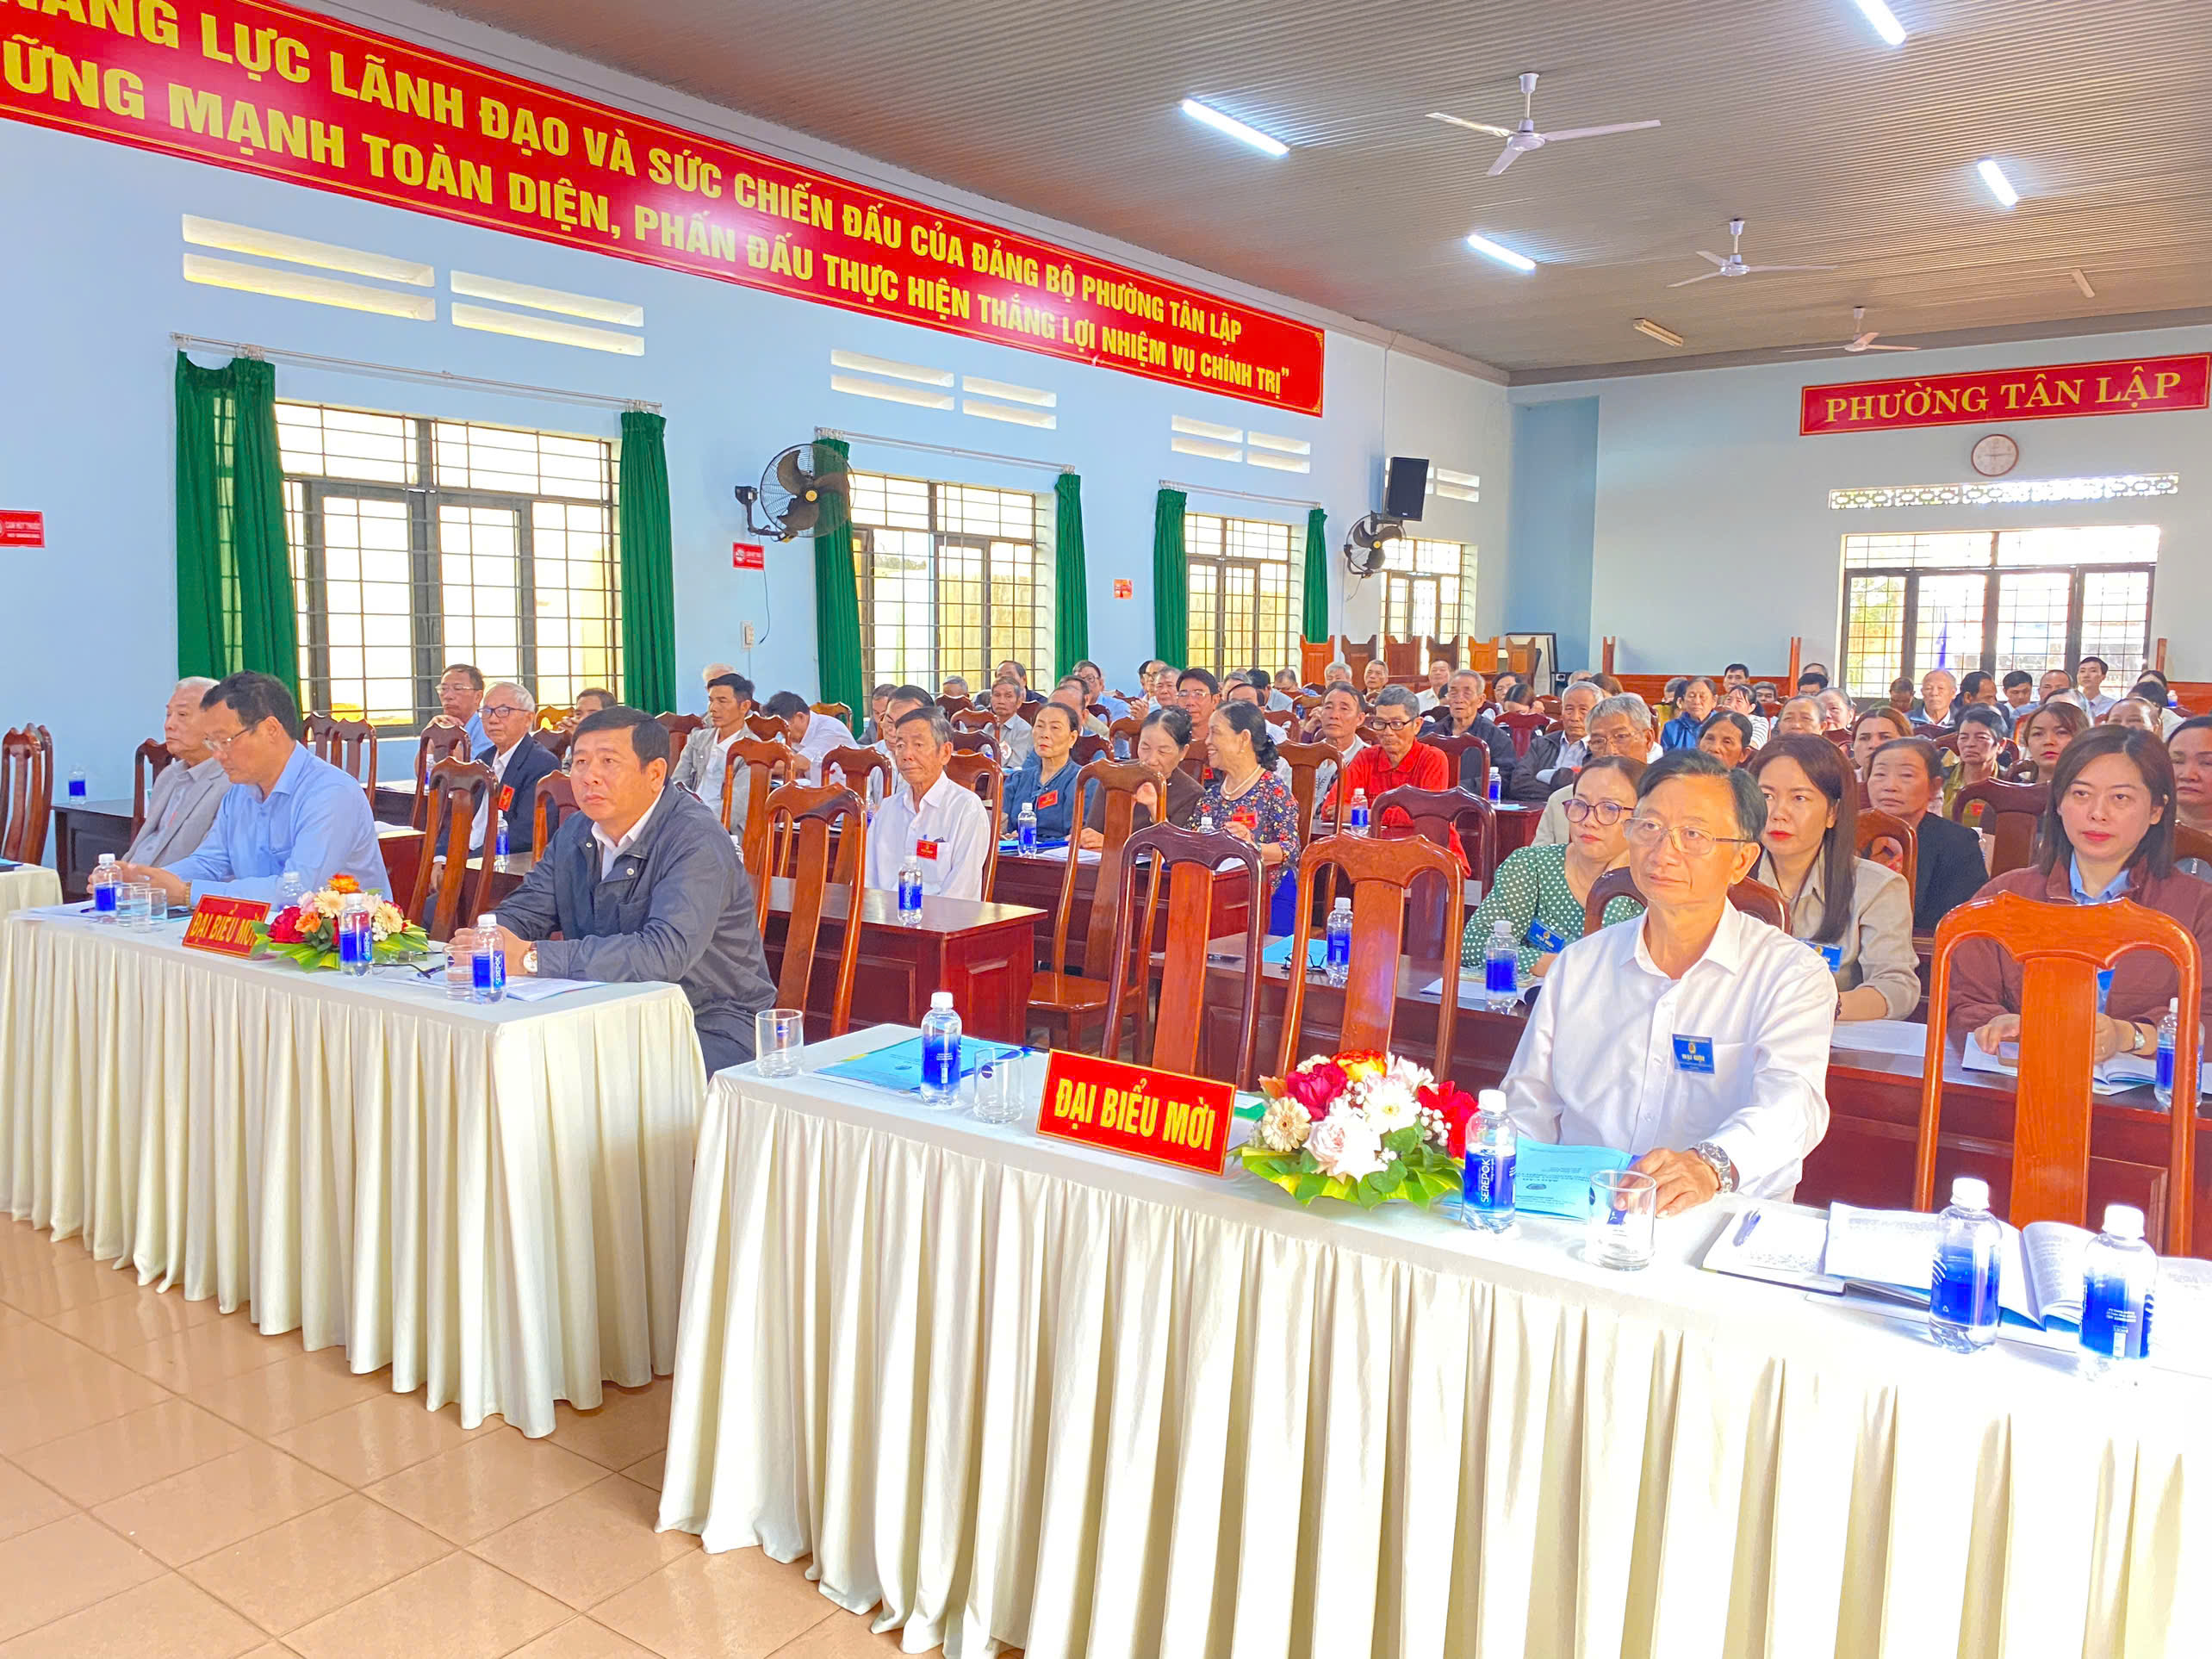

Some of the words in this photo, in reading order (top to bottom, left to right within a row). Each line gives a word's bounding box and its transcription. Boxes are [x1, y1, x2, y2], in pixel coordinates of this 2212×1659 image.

[201, 13, 310, 83] LỰC
[330, 51, 464, 128] LÃNH
[478, 96, 569, 157] ĐẠO
[582, 127, 637, 177] VÀ
[648, 148, 722, 198] SỨC
[734, 173, 833, 231] CHIẾN
[842, 202, 902, 249] ĐẤU
[910, 221, 965, 268] CỦA
[972, 239, 1039, 287] ĐẢNG
[1046, 264, 1075, 301] BỘ
[1082, 275, 1164, 322] PHƯỜNG
[1170, 301, 1205, 339] TÂN
[1209, 311, 1241, 345] LẬP
[168, 83, 345, 169] MẠNH
[361, 133, 493, 205] TOÀN
[509, 172, 620, 239] DIỆN,
[635, 205, 734, 263] PHẤN
[747, 231, 813, 281] ĐẤU
[823, 252, 898, 302] THỰC
[908, 276, 970, 320] HIỆN
[978, 292, 1056, 339] THẮNG
[1063, 315, 1096, 351] LỢI
[1102, 326, 1166, 367] NHIỆM
[1171, 345, 1195, 378] VỤ
[1200, 351, 1252, 388] CHÍNH
[1825, 382, 1988, 423] PHƯỜNG
[2000, 373, 2082, 409] TÂN
[2096, 365, 2181, 409] LẬP
[1054, 1078, 1097, 1129] ĐẠI
[1100, 1078, 1159, 1138] BIỂU
[1163, 1097, 1215, 1151] MỜI
[1481, 1159, 1491, 1202] SEREPOK
